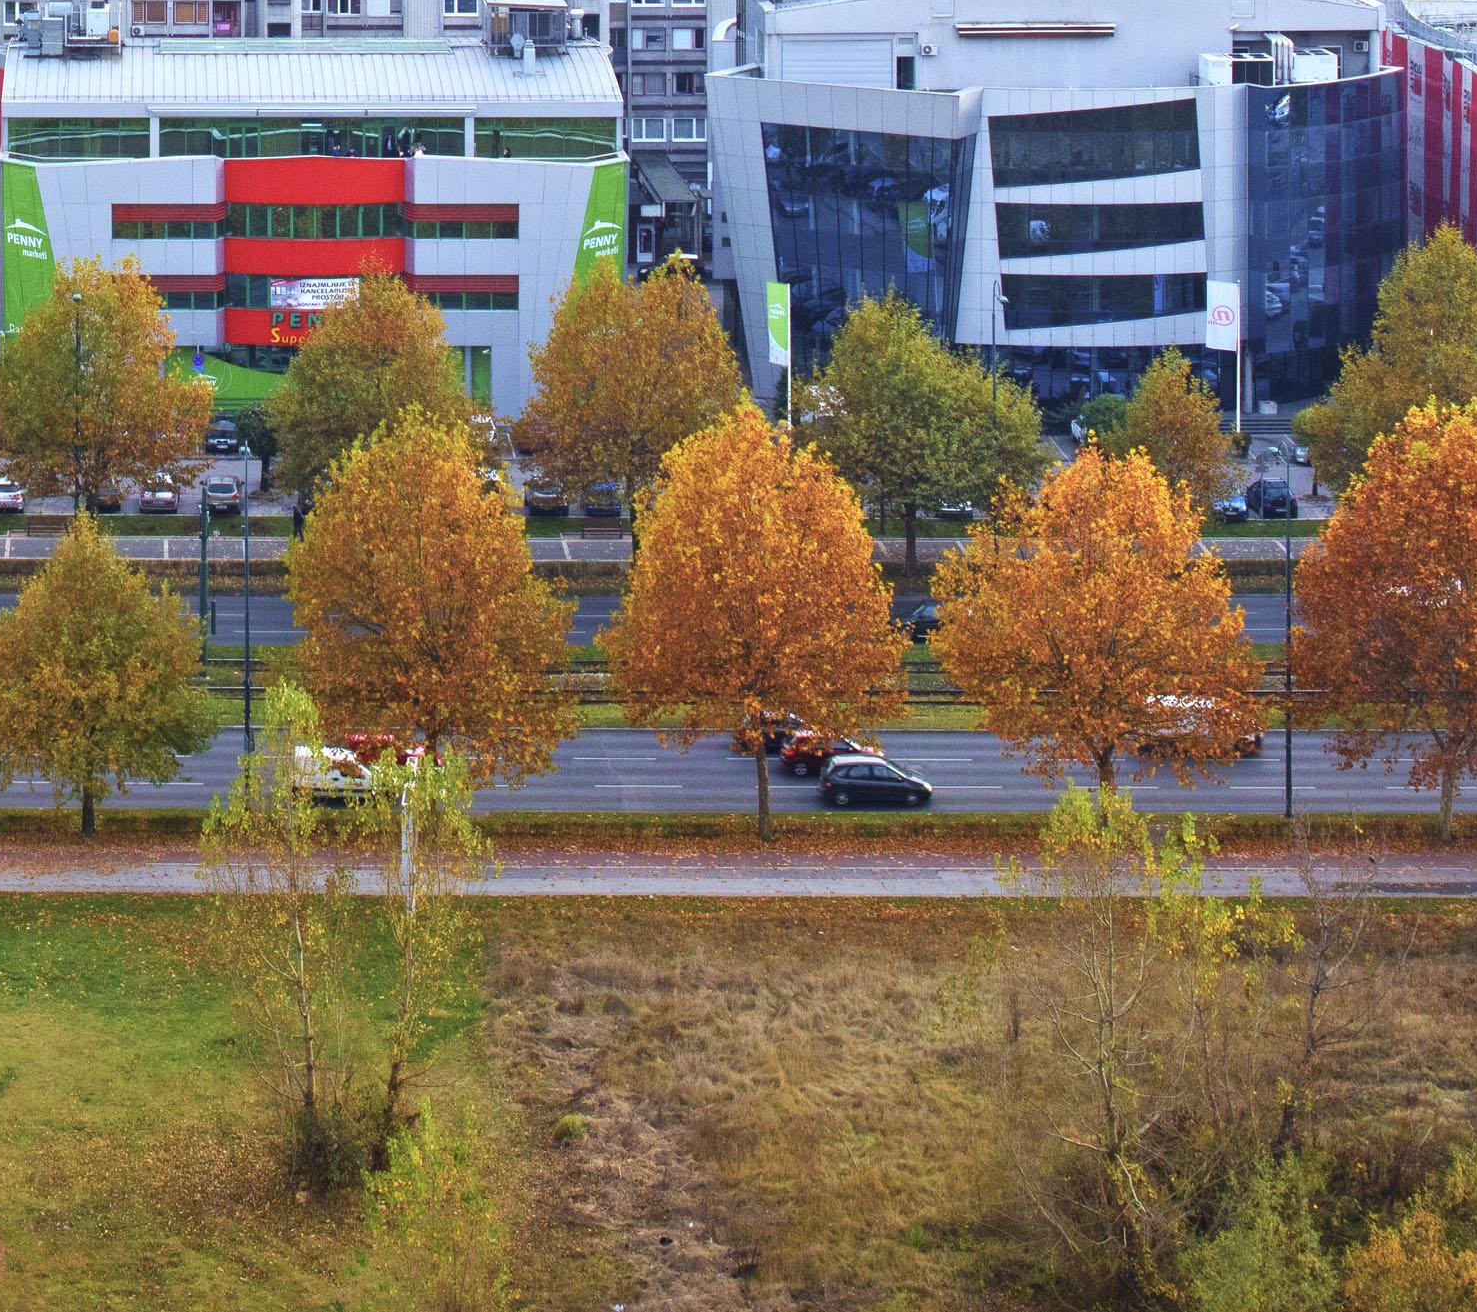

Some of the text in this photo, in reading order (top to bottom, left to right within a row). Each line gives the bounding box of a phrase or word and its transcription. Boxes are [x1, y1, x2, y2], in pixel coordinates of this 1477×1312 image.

[7, 233, 43, 249] PENNY
[583, 233, 618, 250] PENNY
[271, 311, 324, 329] PEN
